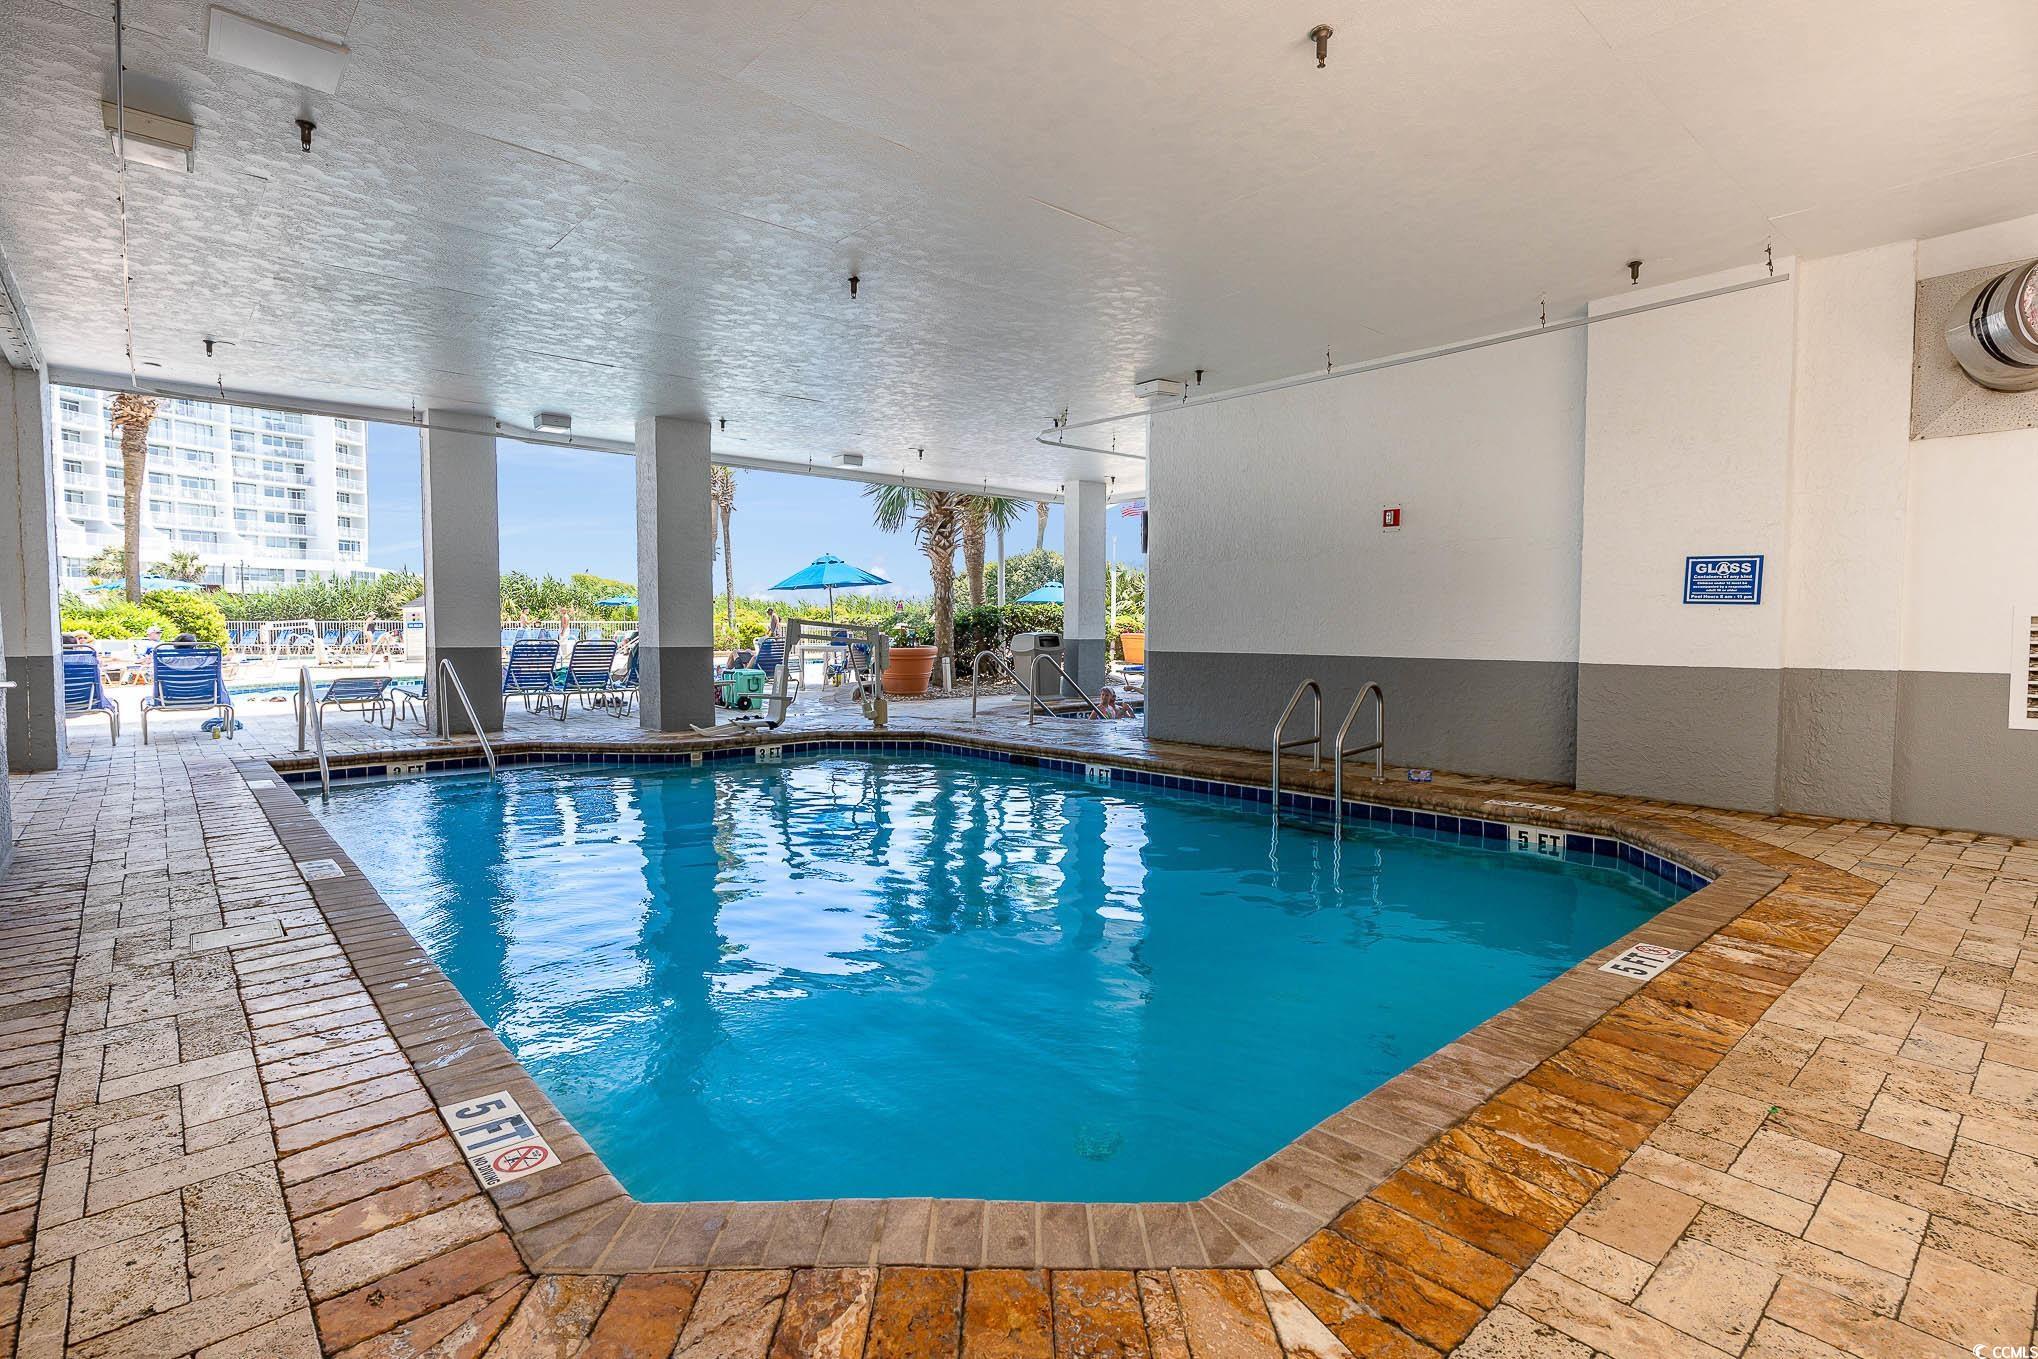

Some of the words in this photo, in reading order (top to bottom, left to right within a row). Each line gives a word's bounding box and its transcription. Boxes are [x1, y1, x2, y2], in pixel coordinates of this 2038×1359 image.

[1695, 562, 1752, 575] GLASS
[1518, 830, 1529, 845] 5
[1538, 834, 1560, 848] FT
[1621, 952, 1664, 968] FT
[1610, 964, 1648, 975] 5
[455, 1099, 507, 1119] 5
[458, 1114, 535, 1151] FT
